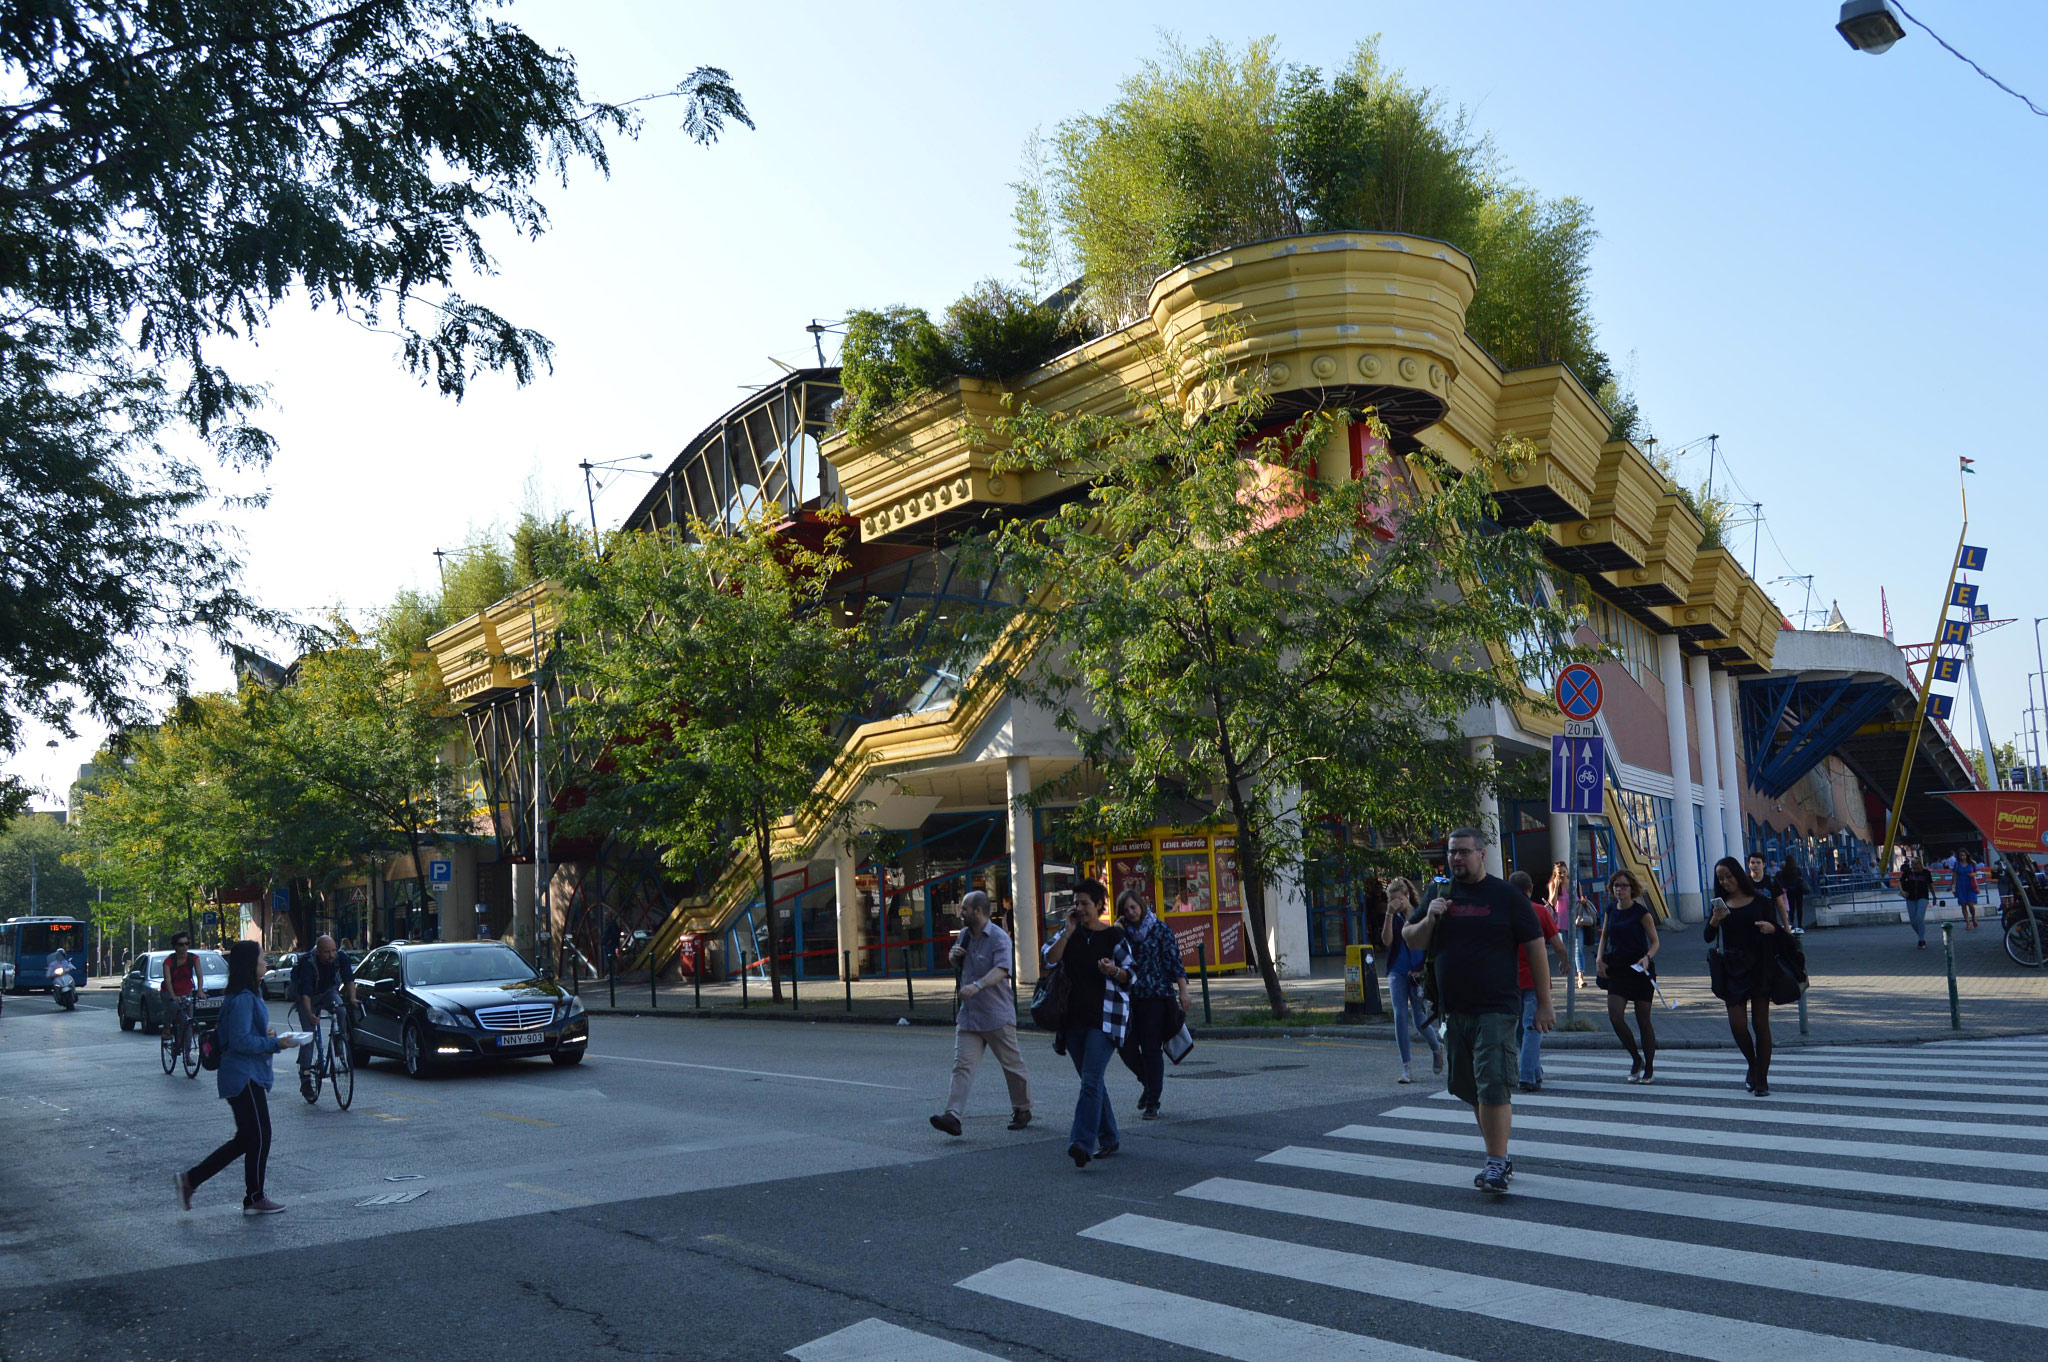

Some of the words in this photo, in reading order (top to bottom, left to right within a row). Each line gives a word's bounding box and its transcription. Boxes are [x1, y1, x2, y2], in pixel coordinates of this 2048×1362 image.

[1568, 724, 1580, 735] 20
[1583, 727, 1590, 735] m
[1997, 812, 2037, 824] PENNY
[434, 863, 447, 879] P
[205, 914, 213, 925] P
[503, 1033, 543, 1044] NNY-903
